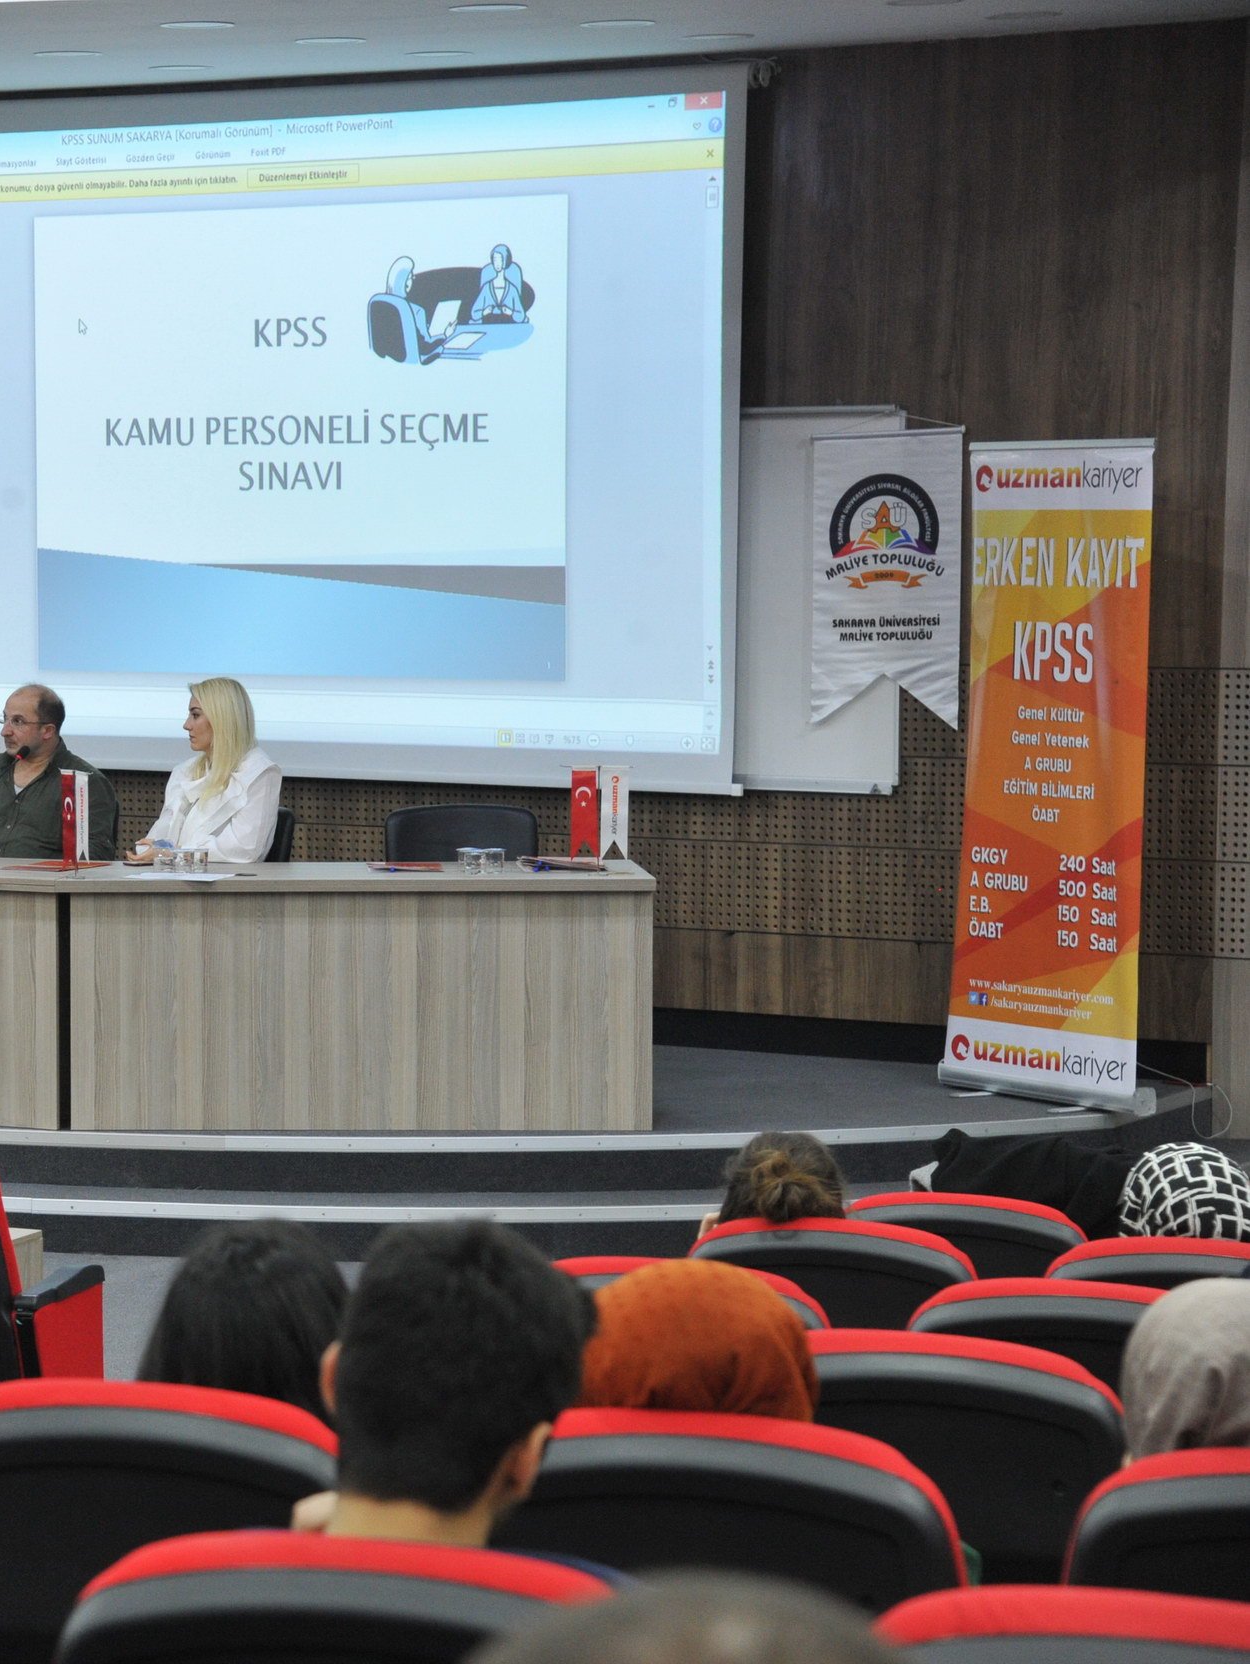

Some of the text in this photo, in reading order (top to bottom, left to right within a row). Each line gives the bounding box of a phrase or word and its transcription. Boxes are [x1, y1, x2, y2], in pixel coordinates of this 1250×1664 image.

[61, 134, 85, 146] KPSS
[87, 132, 124, 145] SUNUM
[126, 130, 172, 143] SAKARYA
[286, 122, 333, 136] Microsoft
[336, 118, 393, 132] PowerPoint
[56, 157, 73, 167] Slayt
[251, 148, 269, 157] Foxit
[271, 147, 286, 156] PDF
[34, 183, 55, 193] dosya
[57, 182, 84, 192] güvenli
[129, 179, 148, 188] Daha
[150, 178, 168, 187] fazla
[194, 176, 208, 186] için
[259, 170, 348, 182] Düzenlemeyi Etkinleştir
[254, 316, 327, 348] KPSS
[105, 409, 489, 451] KAMU PERSONELİ SEÇME
[239, 460, 343, 492] SINAVI
[997, 461, 1143, 495] uzmankariyer
[825, 553, 945, 580] MALİYE TOPLULUĞU
[973, 535, 1145, 588] ERKEN KAYIT
[832, 613, 940, 628] SAKARYA ÜNİVERSİTESİ
[839, 628, 933, 642] MALİYE TOPLULUĞU
[1013, 620, 1094, 683] KPSS
[1018, 706, 1085, 723] Genel Kültür
[1011, 730, 1089, 748] Genel Yetenek
[1024, 757, 1071, 773] A GRUBU
[1003, 778, 1095, 800] EĞİTİM BİLİMLERİ
[1032, 804, 1060, 823] ÖABT
[971, 846, 1116, 876] GKGY 240 Saat
[970, 871, 1117, 902] A GRUBU 500 Saat
[969, 895, 1117, 928] E.B. 150 Saat
[969, 918, 1117, 953] ÖABT 150 Saat
[969, 978, 1114, 1006] www.sakaryauzmankariyer.com
[973, 1039, 1127, 1084] uzmankariyer
